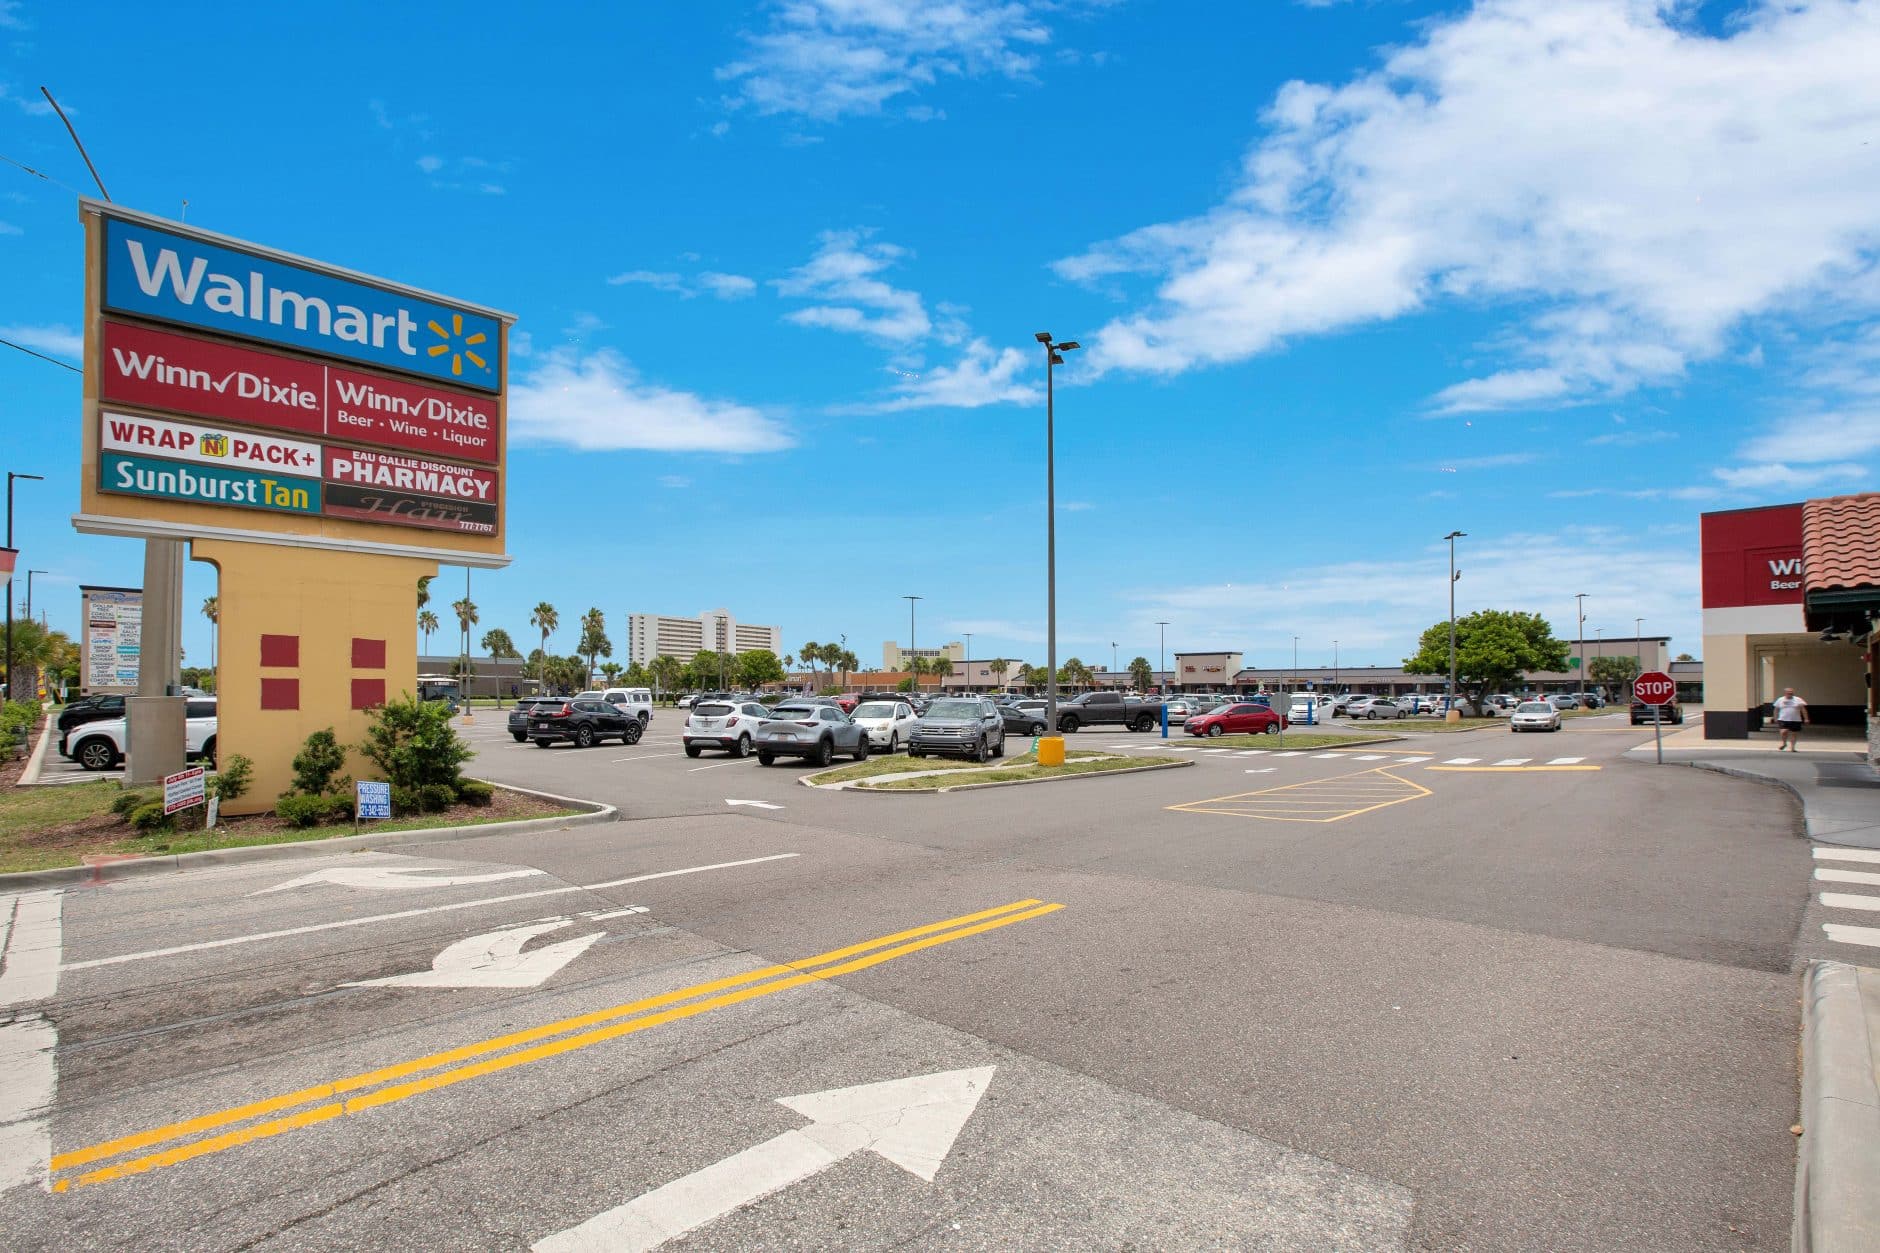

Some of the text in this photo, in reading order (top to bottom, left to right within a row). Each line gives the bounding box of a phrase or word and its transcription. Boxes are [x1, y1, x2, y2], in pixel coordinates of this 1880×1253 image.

[126, 240, 416, 356] Walmart
[110, 420, 195, 451] WRAP
[338, 410, 487, 447] Beer Wine Liquor
[332, 458, 491, 499] PHARMACY
[352, 450, 475, 477] EAU GALLIE DISCOUNT
[1770, 580, 1802, 590] Beer
[1635, 681, 1673, 695] STOP
